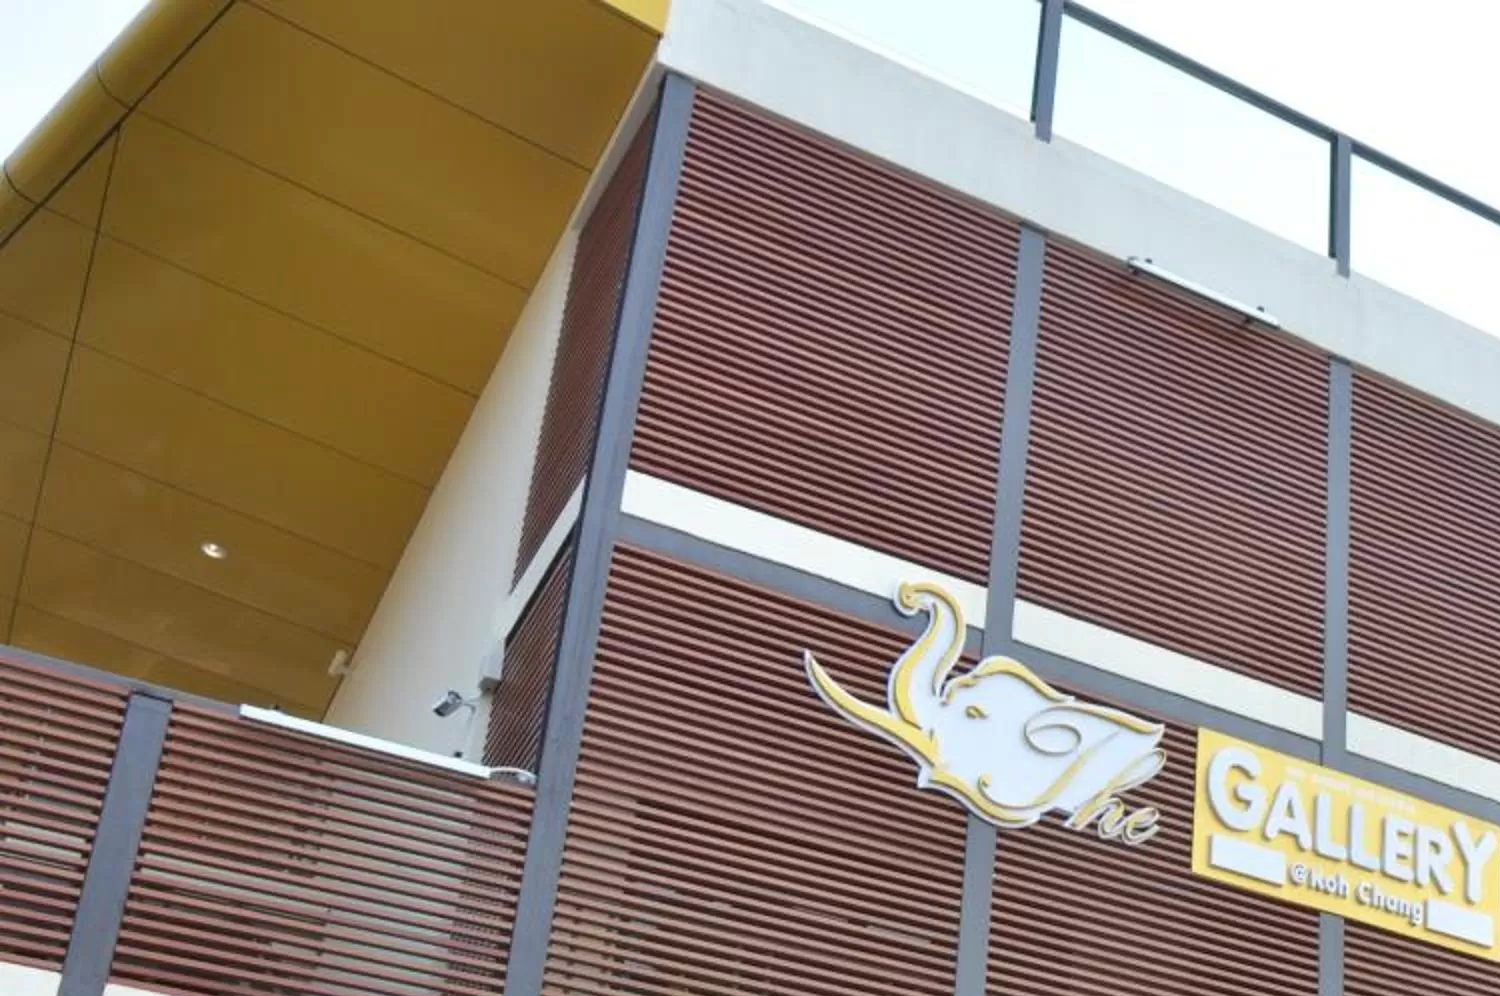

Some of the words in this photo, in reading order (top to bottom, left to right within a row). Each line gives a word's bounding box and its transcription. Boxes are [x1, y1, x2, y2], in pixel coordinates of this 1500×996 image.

[978, 704, 1165, 844] The
[1207, 746, 1498, 904] GALLERY
[1357, 881, 1423, 926] Chang
